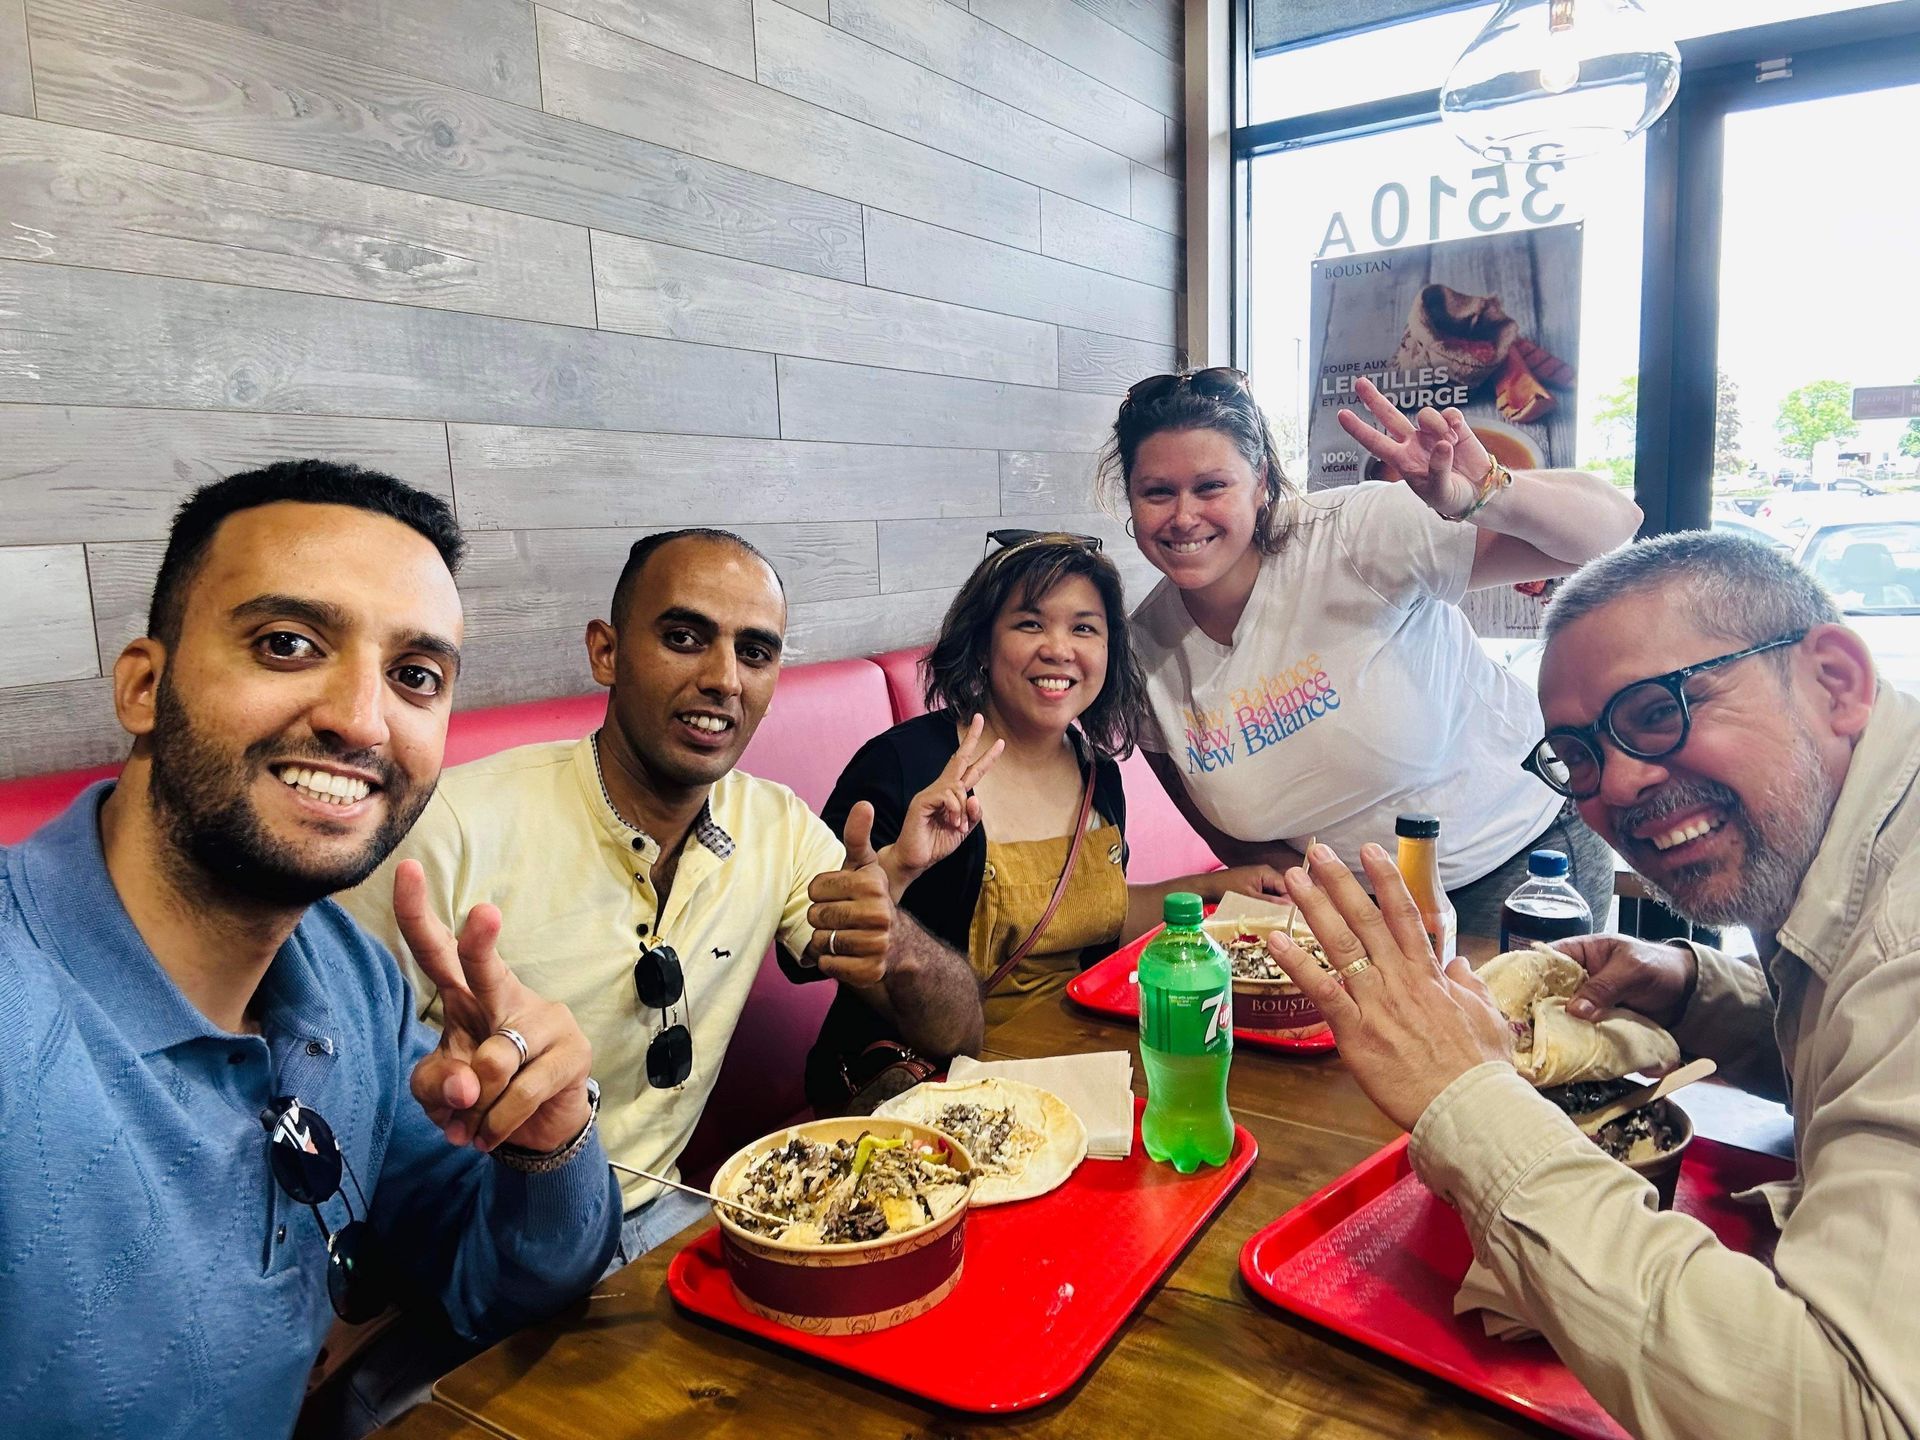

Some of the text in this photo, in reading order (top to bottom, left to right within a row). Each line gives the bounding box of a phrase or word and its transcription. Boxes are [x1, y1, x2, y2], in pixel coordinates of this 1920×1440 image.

[1324, 258, 1392, 280] BOUSTAN
[1323, 359, 1388, 375] SOUPE AUX
[1322, 397, 1334, 407] ET
[1348, 395, 1362, 405] LA
[1363, 385, 1469, 412] OURGE
[1321, 450, 1359, 464] 100%
[1321, 463, 1359, 473] VÉGANE
[1185, 671, 1331, 754] New Balance
[1185, 688, 1341, 775] New Balance
[1252, 997, 1316, 1013] BOUSTA
